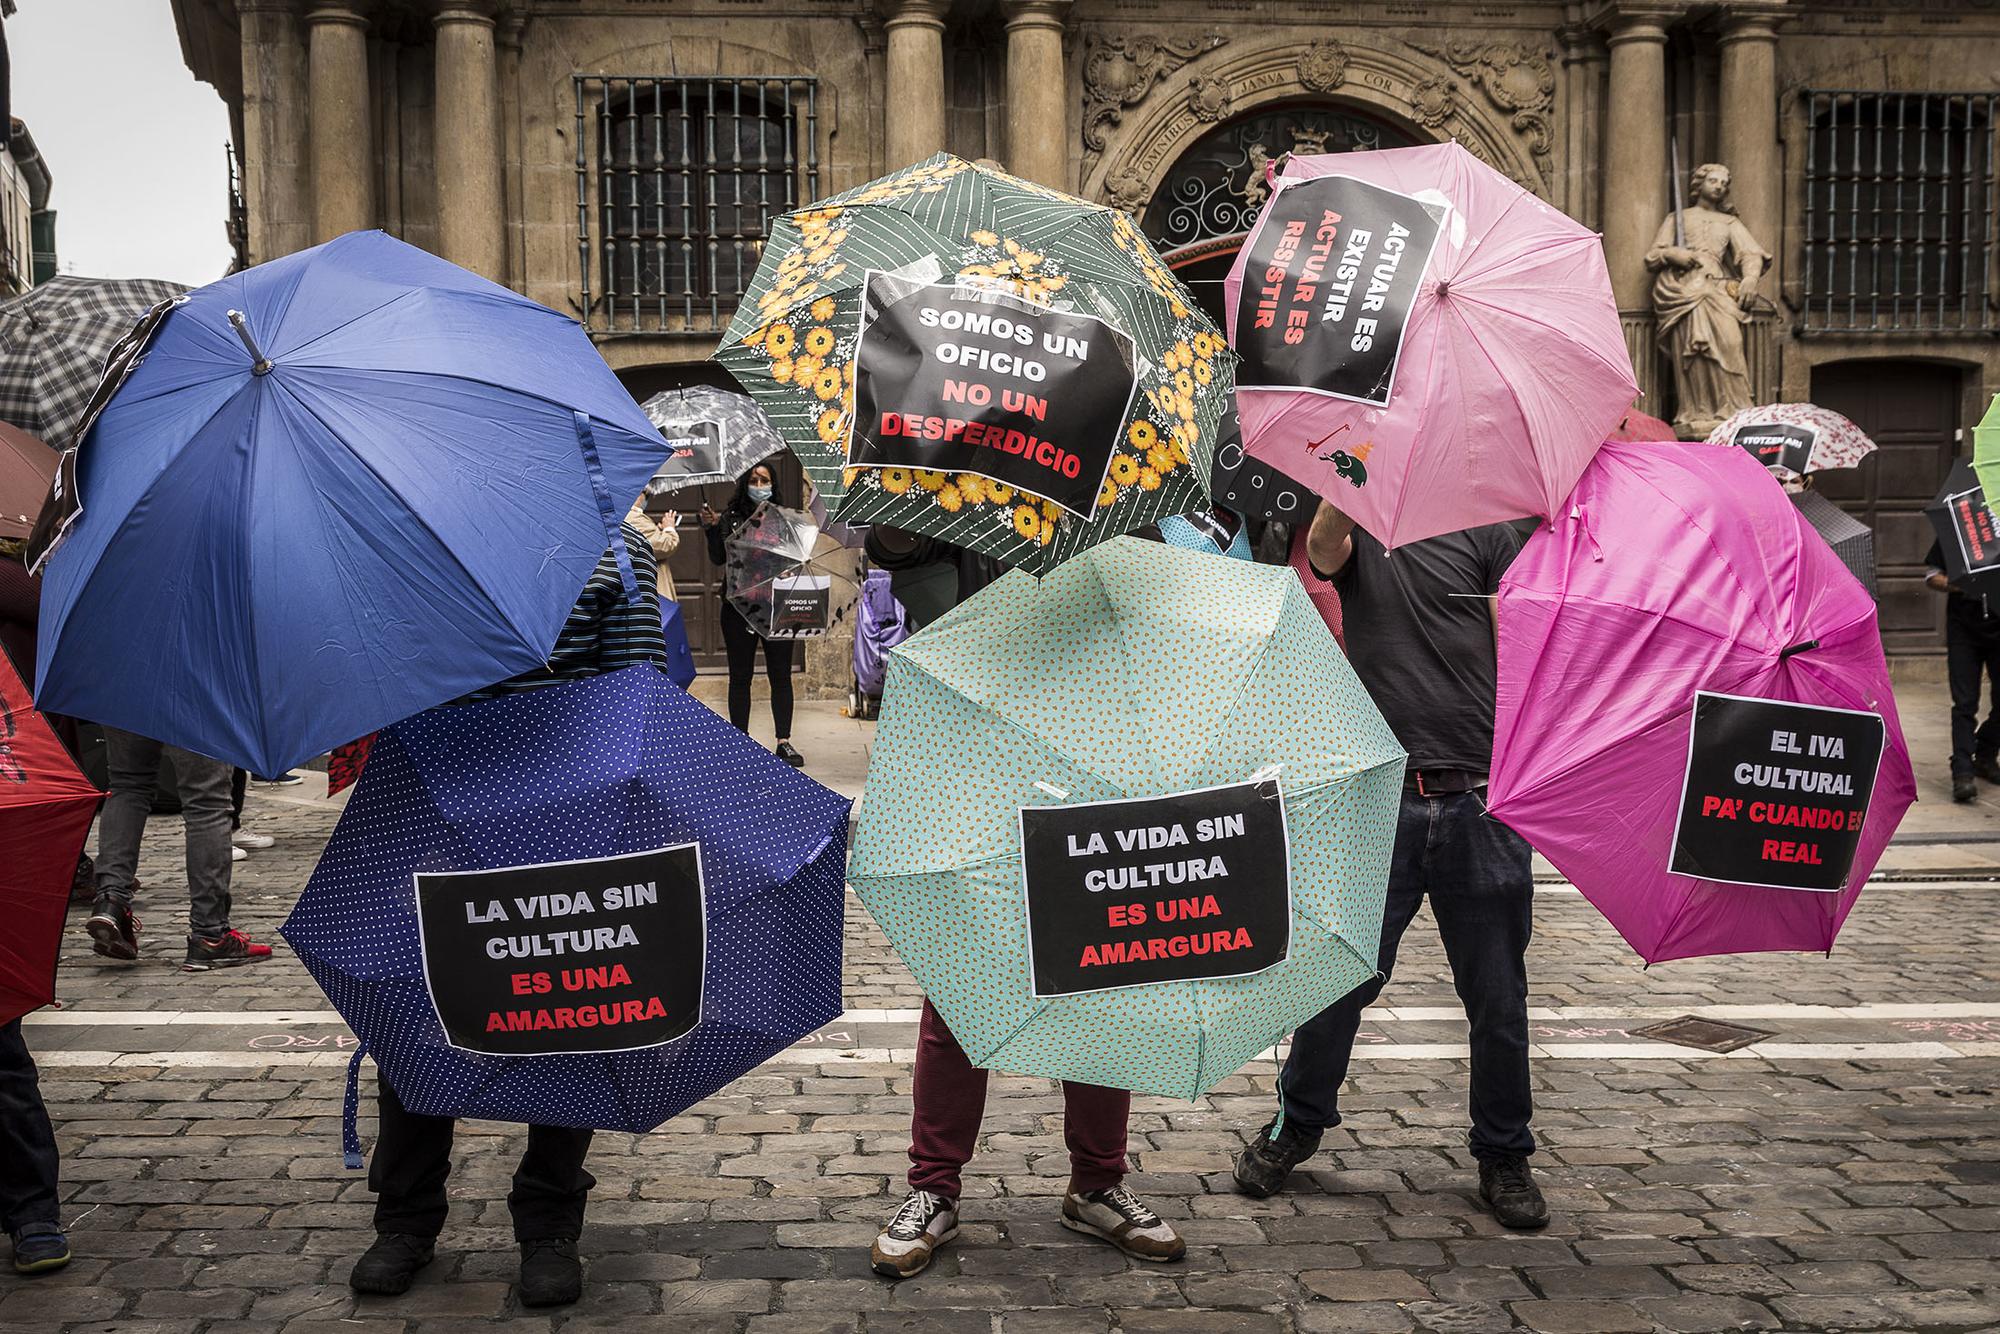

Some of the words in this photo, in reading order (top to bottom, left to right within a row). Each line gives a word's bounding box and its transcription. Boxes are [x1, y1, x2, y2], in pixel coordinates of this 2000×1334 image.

[1142, 114, 1195, 171] OMNIBUS
[1240, 72, 1287, 93] JANVA
[1363, 72, 1394, 91] COR
[1292, 209, 1344, 303] ACTUAR
[1360, 221, 1411, 313] ACTUAR
[1254, 220, 1307, 330] RESISTIR
[1321, 228, 1373, 323] EXISTIR
[918, 306, 1034, 346] SOMOS
[1042, 333, 1089, 360] UN
[1283, 309, 1309, 345] ES
[1350, 316, 1379, 353] ES
[935, 343, 1047, 382] OFICIO
[942, 379, 992, 405] NO
[1001, 389, 1048, 421] UN
[880, 412, 1082, 479] DESPERDICIO
[1976, 511, 1988, 526] NO
[1981, 527, 1993, 542] UN
[1770, 730, 1802, 754] EL
[1808, 735, 1845, 759] IVA
[1734, 762, 1854, 796] CULTURAL
[1067, 832, 1109, 857] LA
[1114, 823, 1190, 852] VIDA
[1196, 813, 1245, 842] SIN
[1749, 801, 1845, 831] CUANDO
[1847, 810, 1863, 832] ES
[1761, 839, 1823, 865] REAL
[1084, 855, 1229, 892] CULTURA
[465, 899, 509, 924] LA
[514, 891, 595, 919] VIDA
[602, 881, 658, 911] SIN
[1107, 903, 1148, 928] ES
[1156, 894, 1222, 922] UNA
[485, 924, 640, 960] CULTURA
[1079, 927, 1254, 967] AMARGURA
[511, 971, 552, 995] ES
[561, 963, 632, 992] UNA
[485, 996, 668, 1032] AMARGURA
